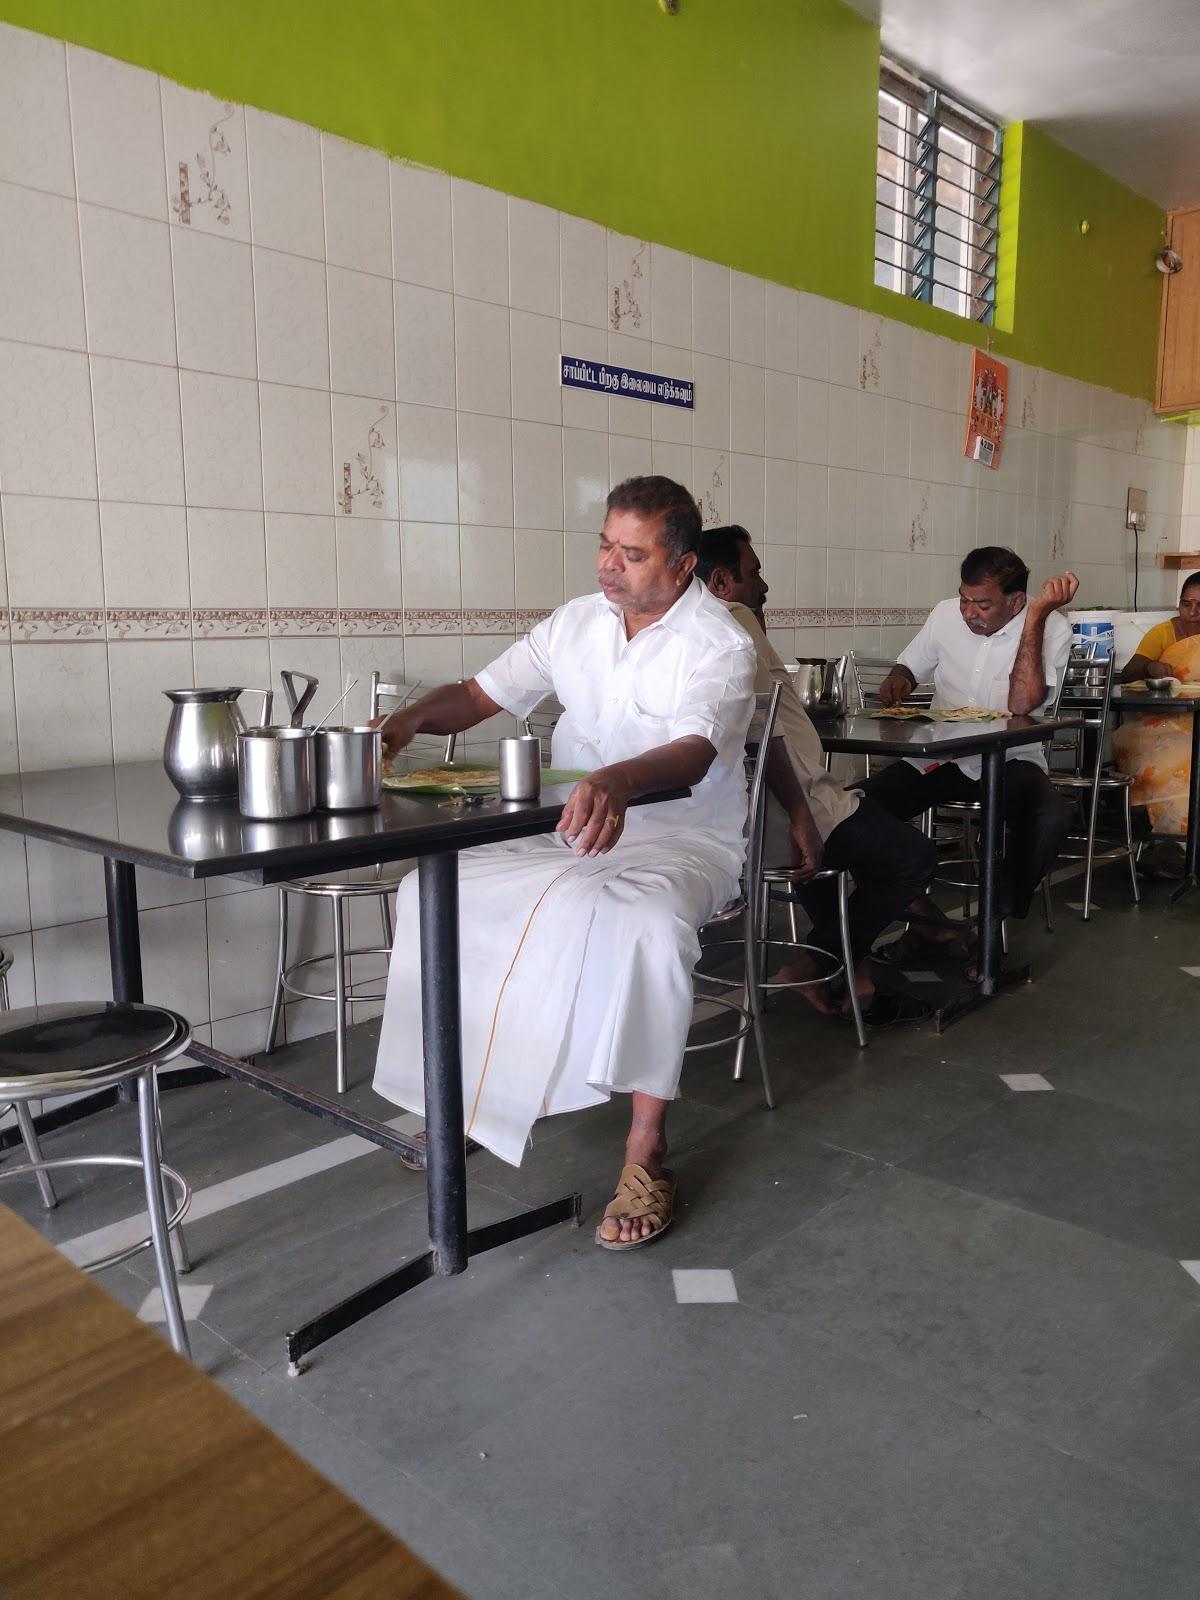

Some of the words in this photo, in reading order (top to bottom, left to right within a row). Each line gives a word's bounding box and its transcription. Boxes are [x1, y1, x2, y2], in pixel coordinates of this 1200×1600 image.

[563, 361, 597, 383] சாப்பிட்ட
[599, 367, 619, 390] பிறகு
[621, 373, 656, 394] இலையை
[658, 380, 692, 403] எடுக்கவும்
